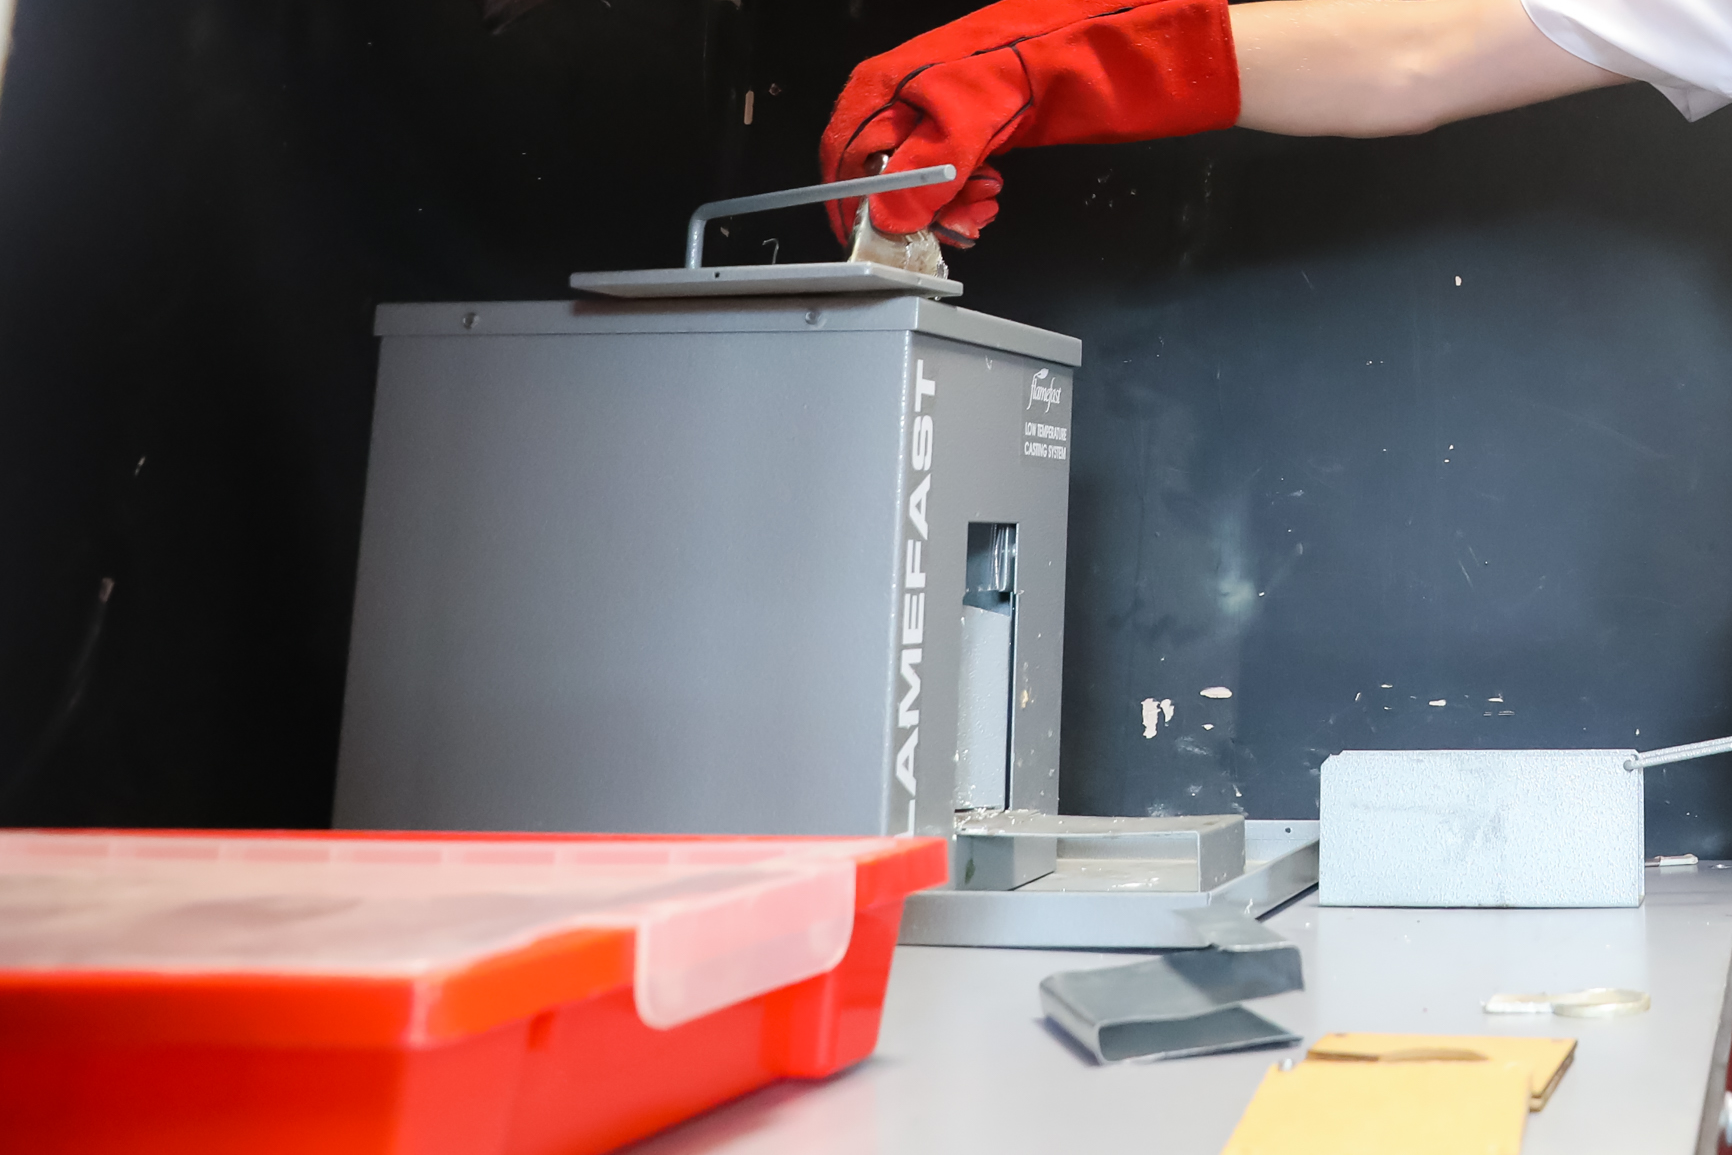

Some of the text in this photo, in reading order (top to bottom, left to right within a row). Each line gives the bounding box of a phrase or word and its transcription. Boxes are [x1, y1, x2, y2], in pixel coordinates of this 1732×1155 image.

[1026, 368, 1062, 413] flamefast
[1024, 421, 1068, 441] LOW TEMPERATURE
[1024, 441, 1067, 460] CASTING SYSTEM
